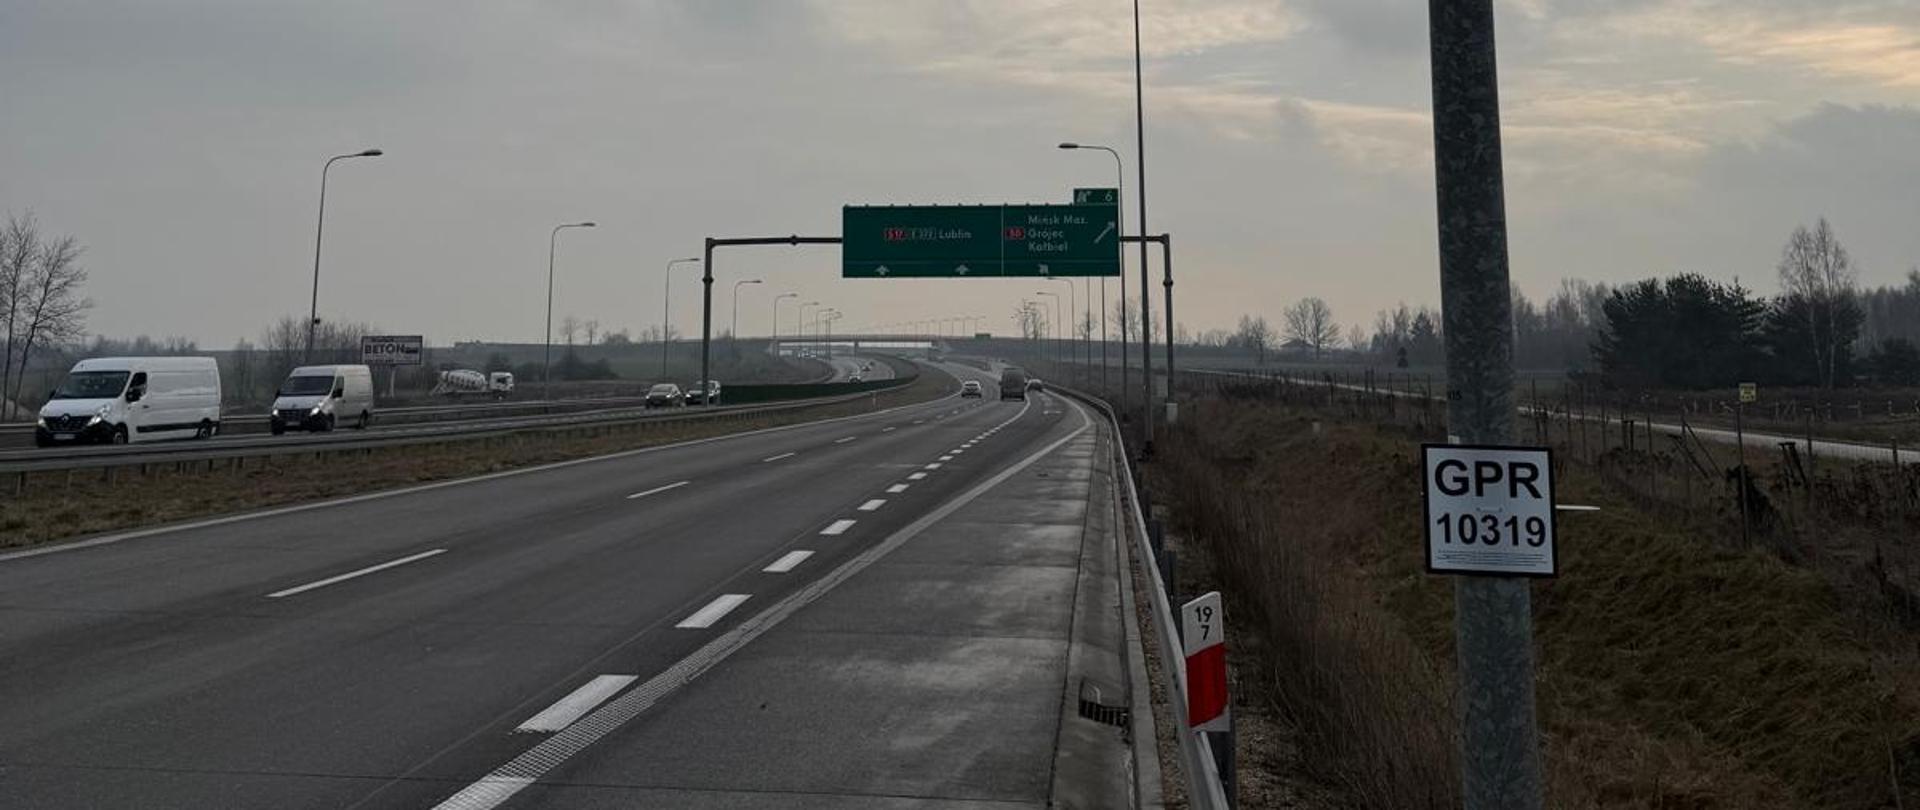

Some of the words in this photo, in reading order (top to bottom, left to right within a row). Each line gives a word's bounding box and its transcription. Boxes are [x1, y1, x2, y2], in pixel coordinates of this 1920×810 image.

[1104, 192, 1113, 202] 6
[1064, 215, 1088, 224] Maz.
[939, 228, 973, 239] Lublin
[1028, 228, 1064, 240] Grójec
[1028, 242, 1068, 252] Kołbiel
[365, 344, 406, 354] BETON
[1435, 459, 1543, 499] GPR
[1437, 513, 1546, 548] 10319
[1195, 606, 1213, 623] 19
[1201, 625, 1210, 640] 7
